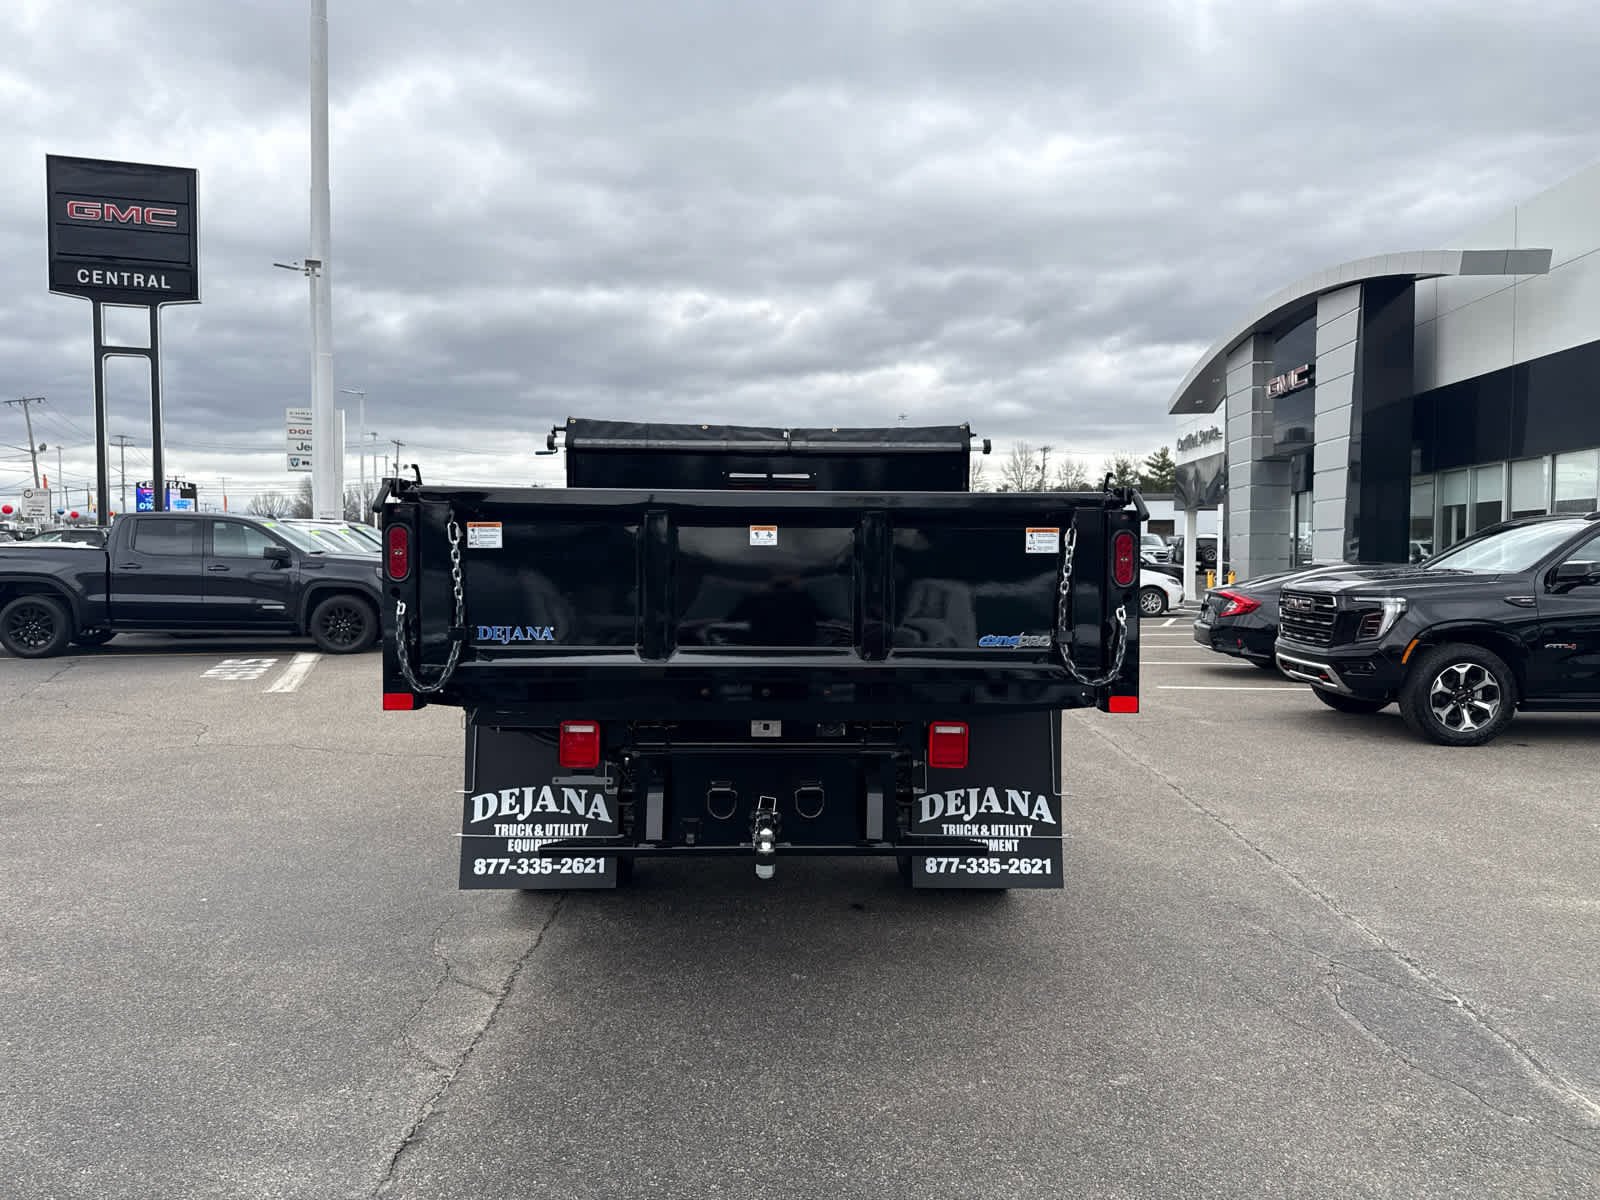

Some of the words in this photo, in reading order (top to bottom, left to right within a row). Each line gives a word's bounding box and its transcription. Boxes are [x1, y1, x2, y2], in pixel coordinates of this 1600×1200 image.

[66, 200, 178, 227] GMC
[77, 269, 171, 289] CENTRAL
[1266, 364, 1309, 399] GMC
[296, 442, 313, 451] Je
[138, 481, 193, 490] CETRAL
[476, 625, 555, 645] DEJANA
[470, 785, 613, 823] DEJANA
[918, 786, 1056, 824] DEJANA
[507, 838, 567, 853] EQUIP
[473, 857, 605, 875] 877-335-2621
[925, 857, 1052, 875] 877-335-2621
